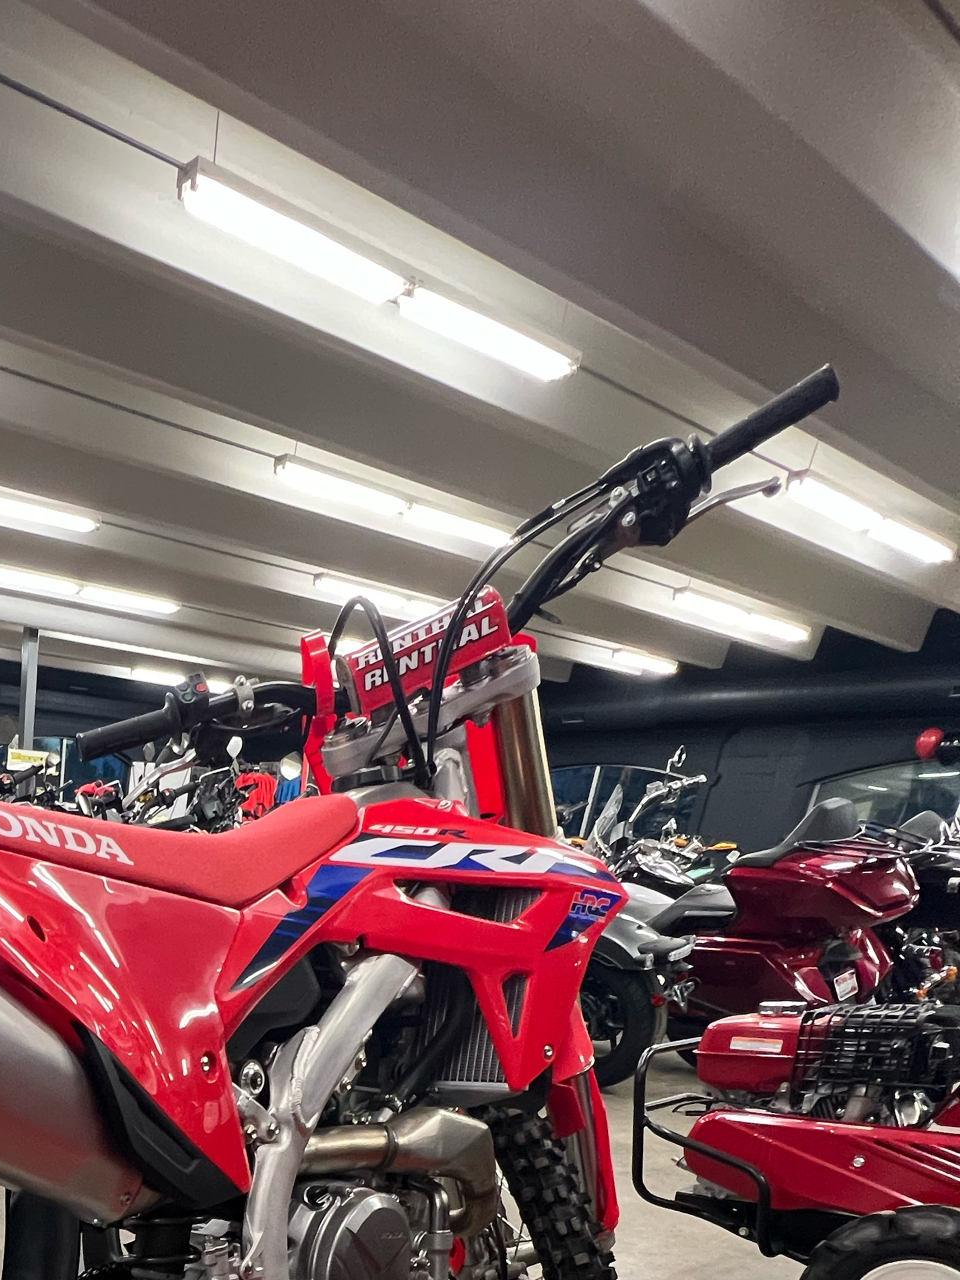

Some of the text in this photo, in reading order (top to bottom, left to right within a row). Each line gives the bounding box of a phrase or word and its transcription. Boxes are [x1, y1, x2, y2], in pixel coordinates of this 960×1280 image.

[364, 616, 499, 691] RNTAL
[368, 824, 471, 840] 450R
[570, 892, 610, 917] HRC
